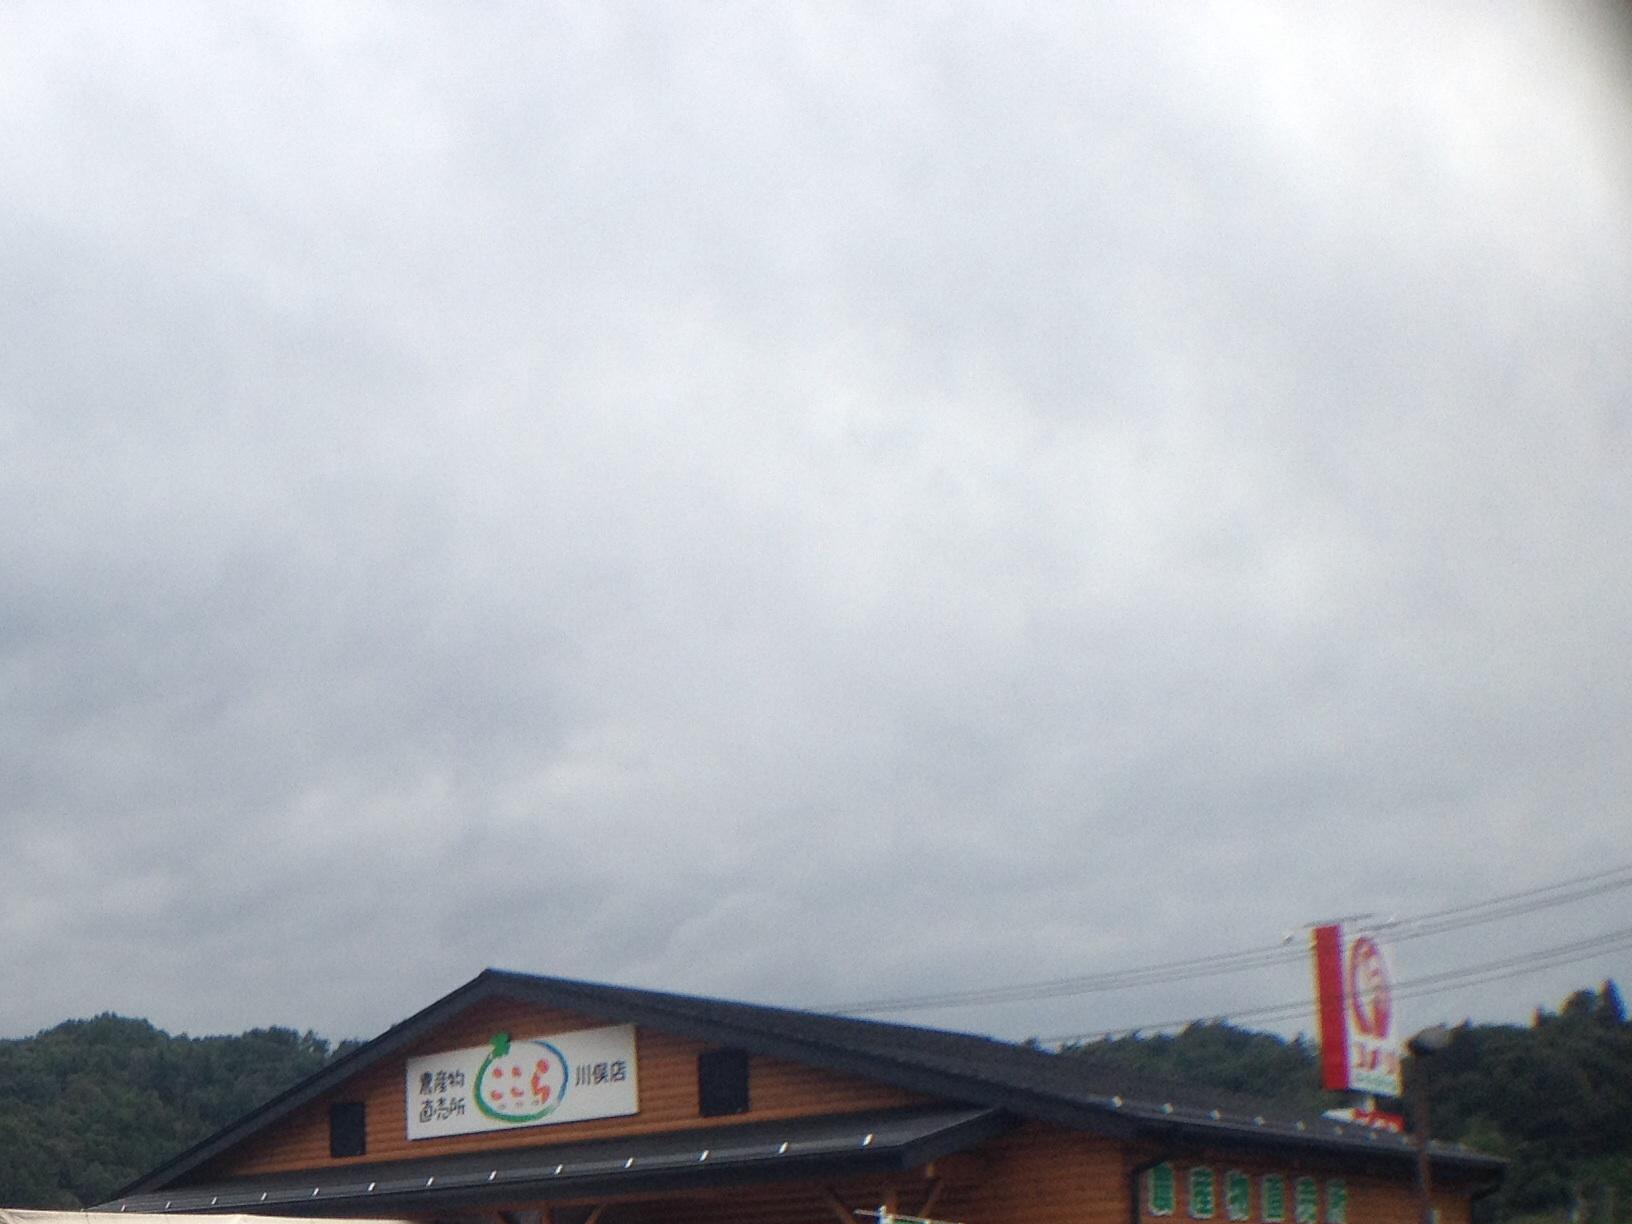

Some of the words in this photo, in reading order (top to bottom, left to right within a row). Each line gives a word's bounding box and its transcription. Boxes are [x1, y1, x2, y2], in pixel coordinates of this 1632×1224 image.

[419, 1068, 466, 1095] 農産物
[575, 1060, 627, 1087] 川俣店
[419, 1097, 466, 1123] 直売所
